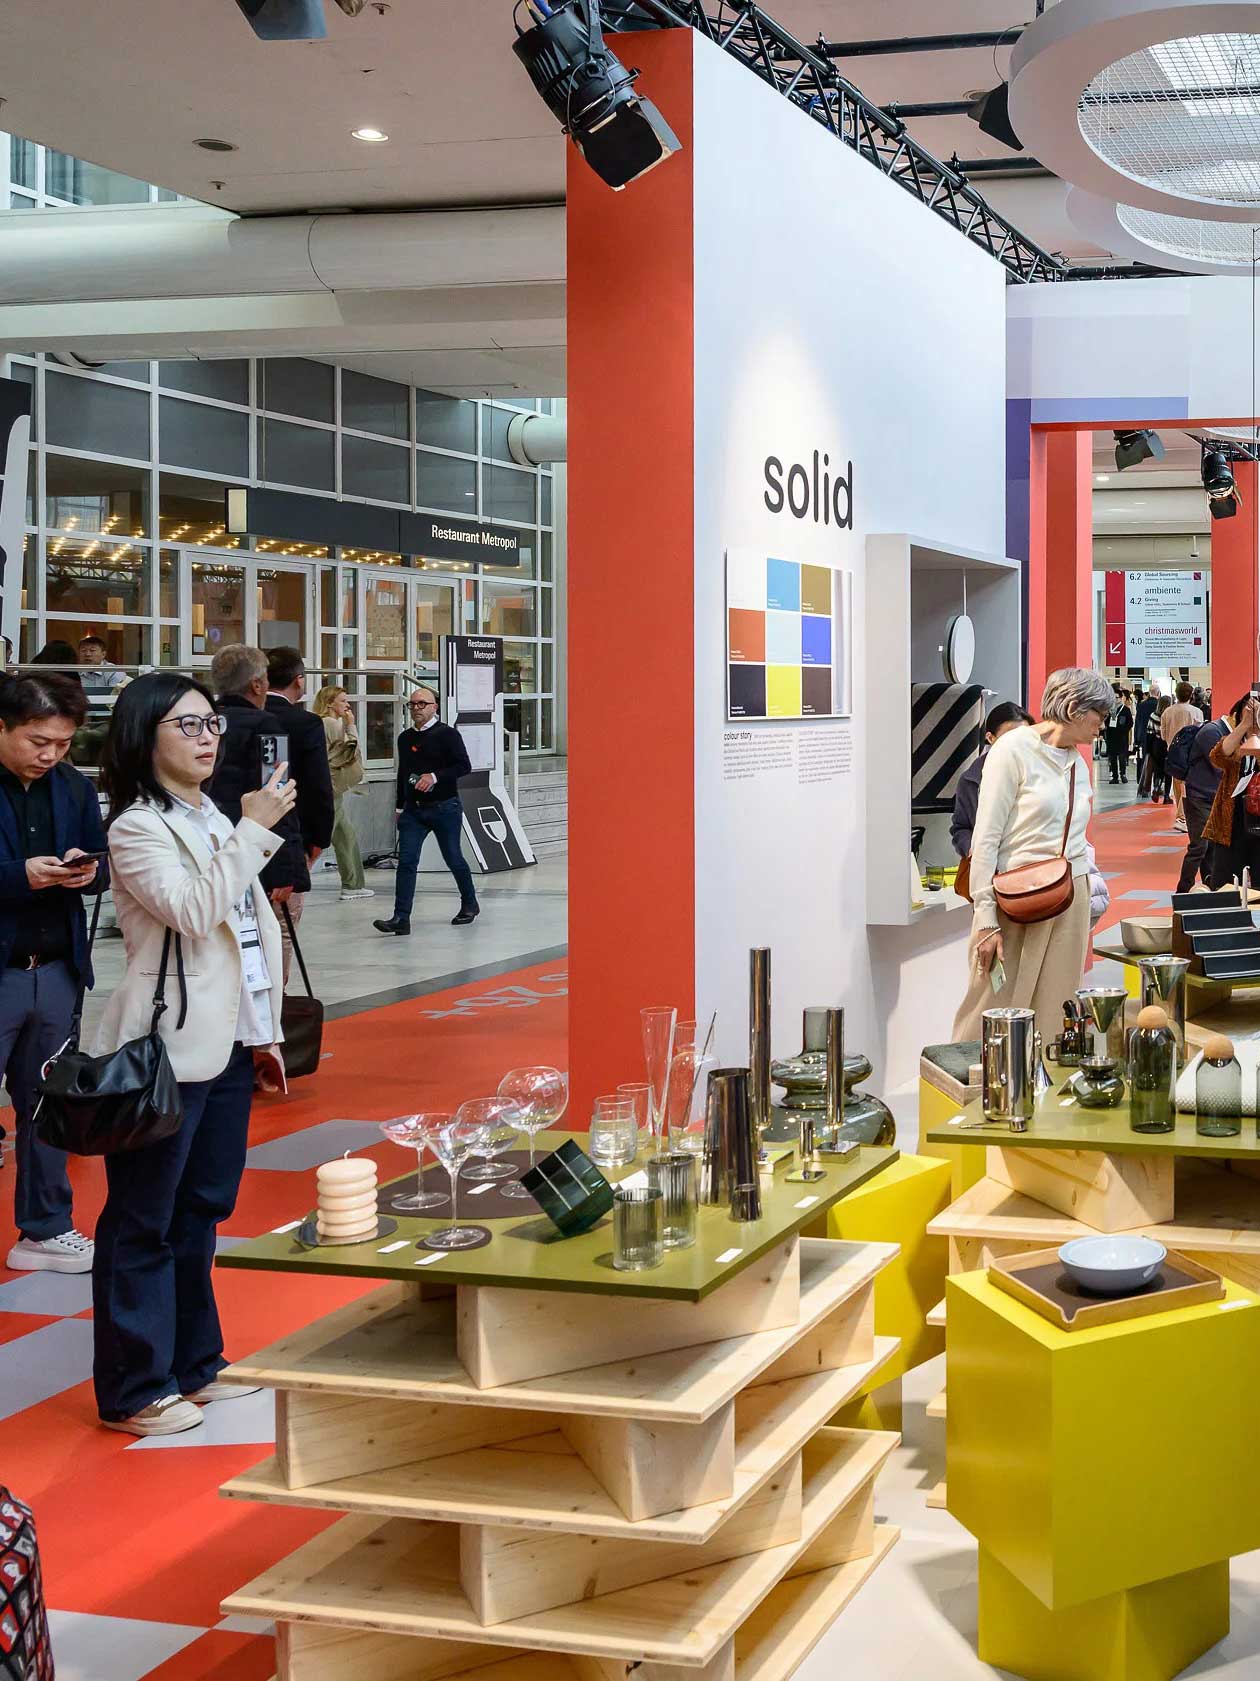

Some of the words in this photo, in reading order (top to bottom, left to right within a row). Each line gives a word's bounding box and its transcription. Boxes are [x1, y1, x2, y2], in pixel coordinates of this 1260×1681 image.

[763, 449, 853, 531] solid
[431, 524, 480, 544] Restaurant
[481, 531, 517, 551] Metropol
[1129, 572, 1141, 581] 6.2
[1144, 586, 1182, 595] ambiente
[1129, 597, 1142, 605] 4.2
[1144, 626, 1198, 635] christmasworld
[467, 638, 496, 649] Restaurant
[1129, 637, 1143, 646] 4.0
[473, 650, 496, 661] Metropol
[723, 731, 740, 741] colour
[740, 730, 753, 741] story
